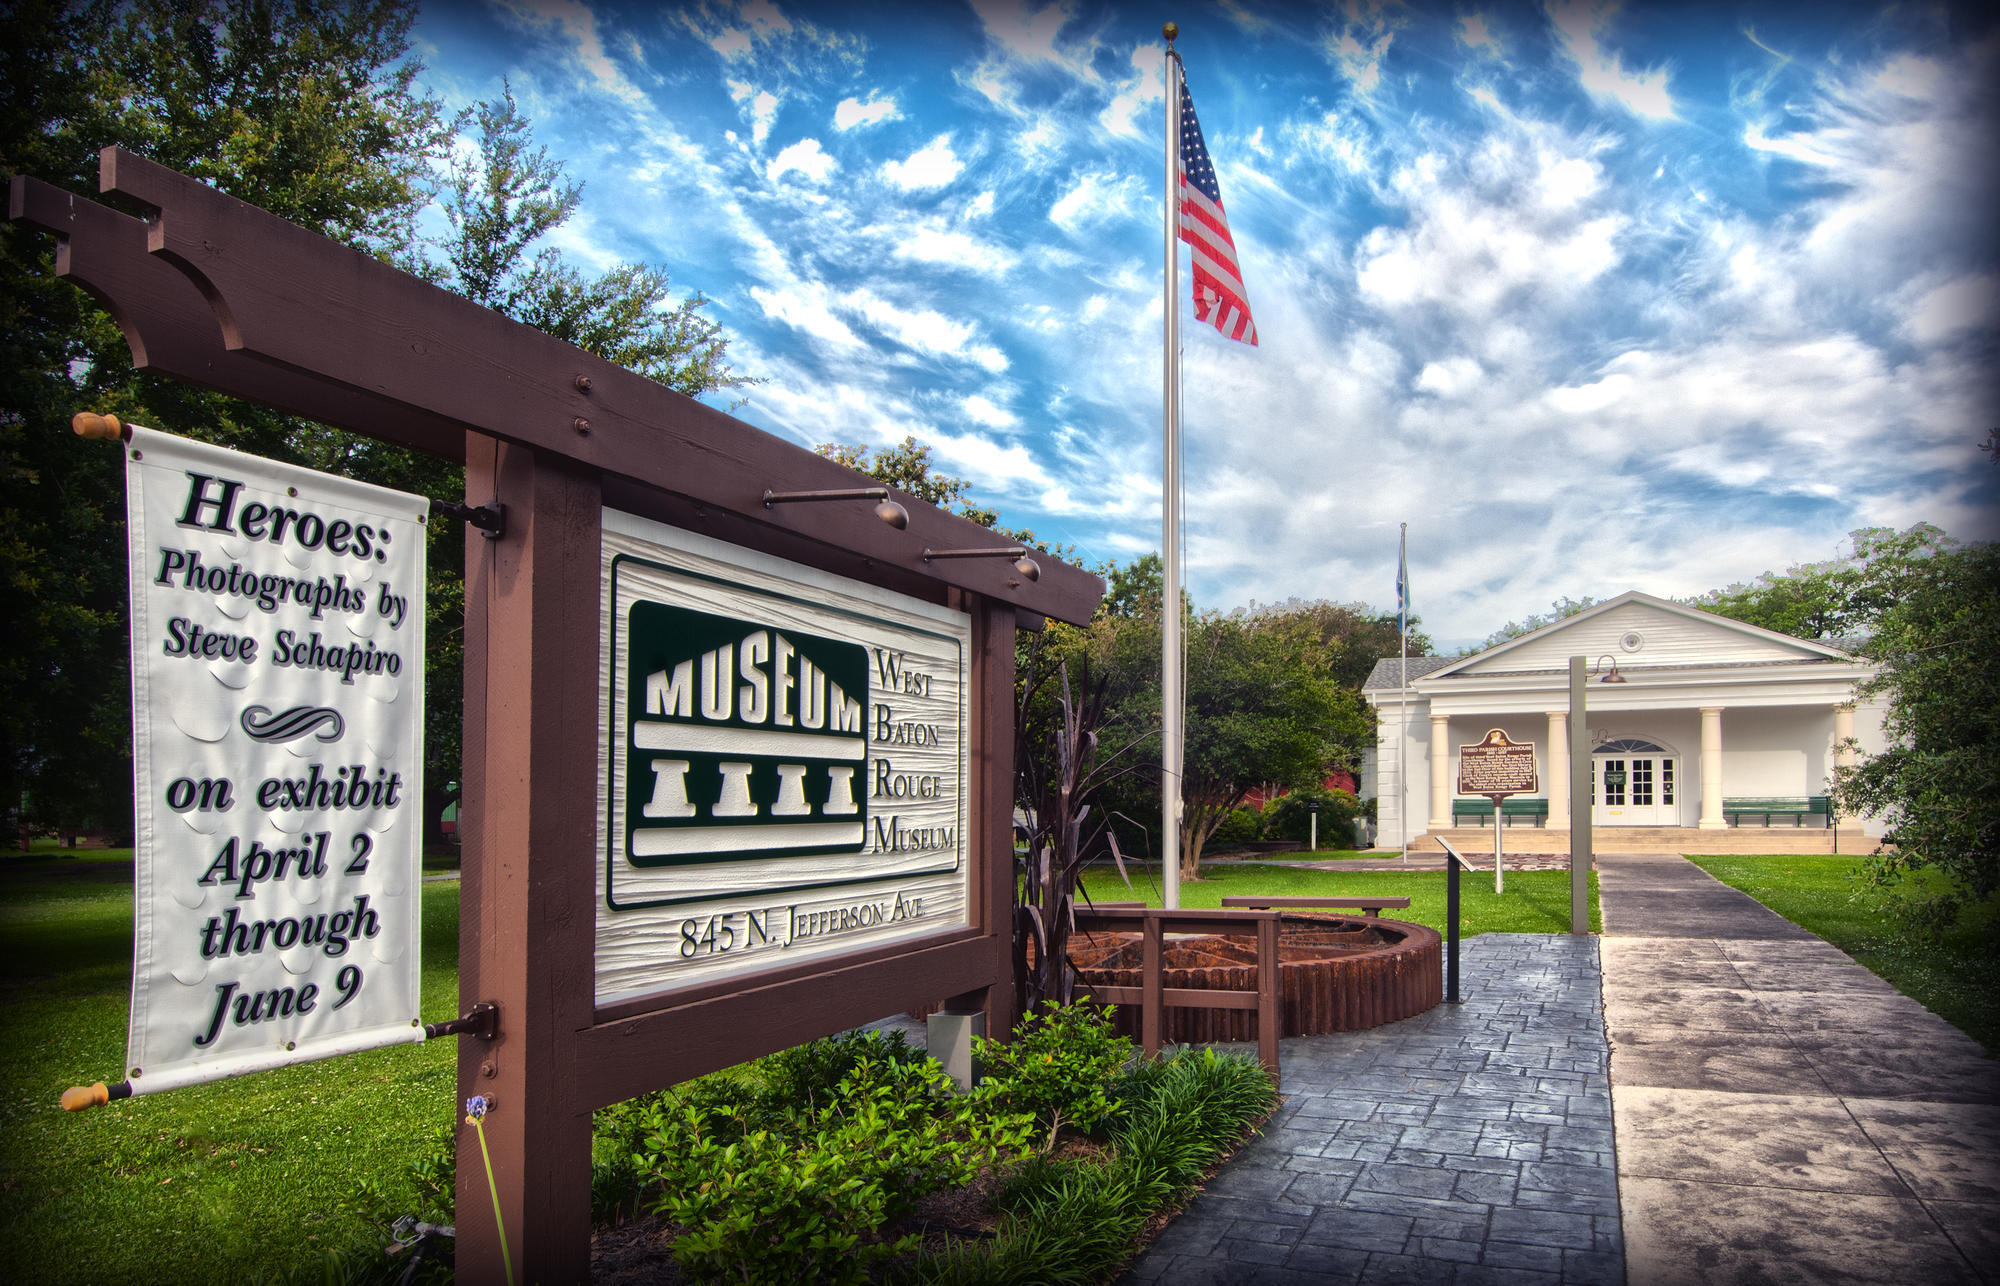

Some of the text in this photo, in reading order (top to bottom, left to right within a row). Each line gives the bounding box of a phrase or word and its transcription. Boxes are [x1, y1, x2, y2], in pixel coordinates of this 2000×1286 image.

[175, 470, 392, 563] Heroes:
[154, 546, 408, 630] Photographs by
[163, 616, 402, 685] Steve Schapiro
[646, 629, 861, 733] MUSEUM
[166, 764, 402, 813] on exhibit
[197, 831, 373, 901] April 2
[199, 894, 381, 960] through
[680, 914, 733, 958] 845
[744, 909, 776, 948] N.
[193, 963, 363, 1047] June 9
